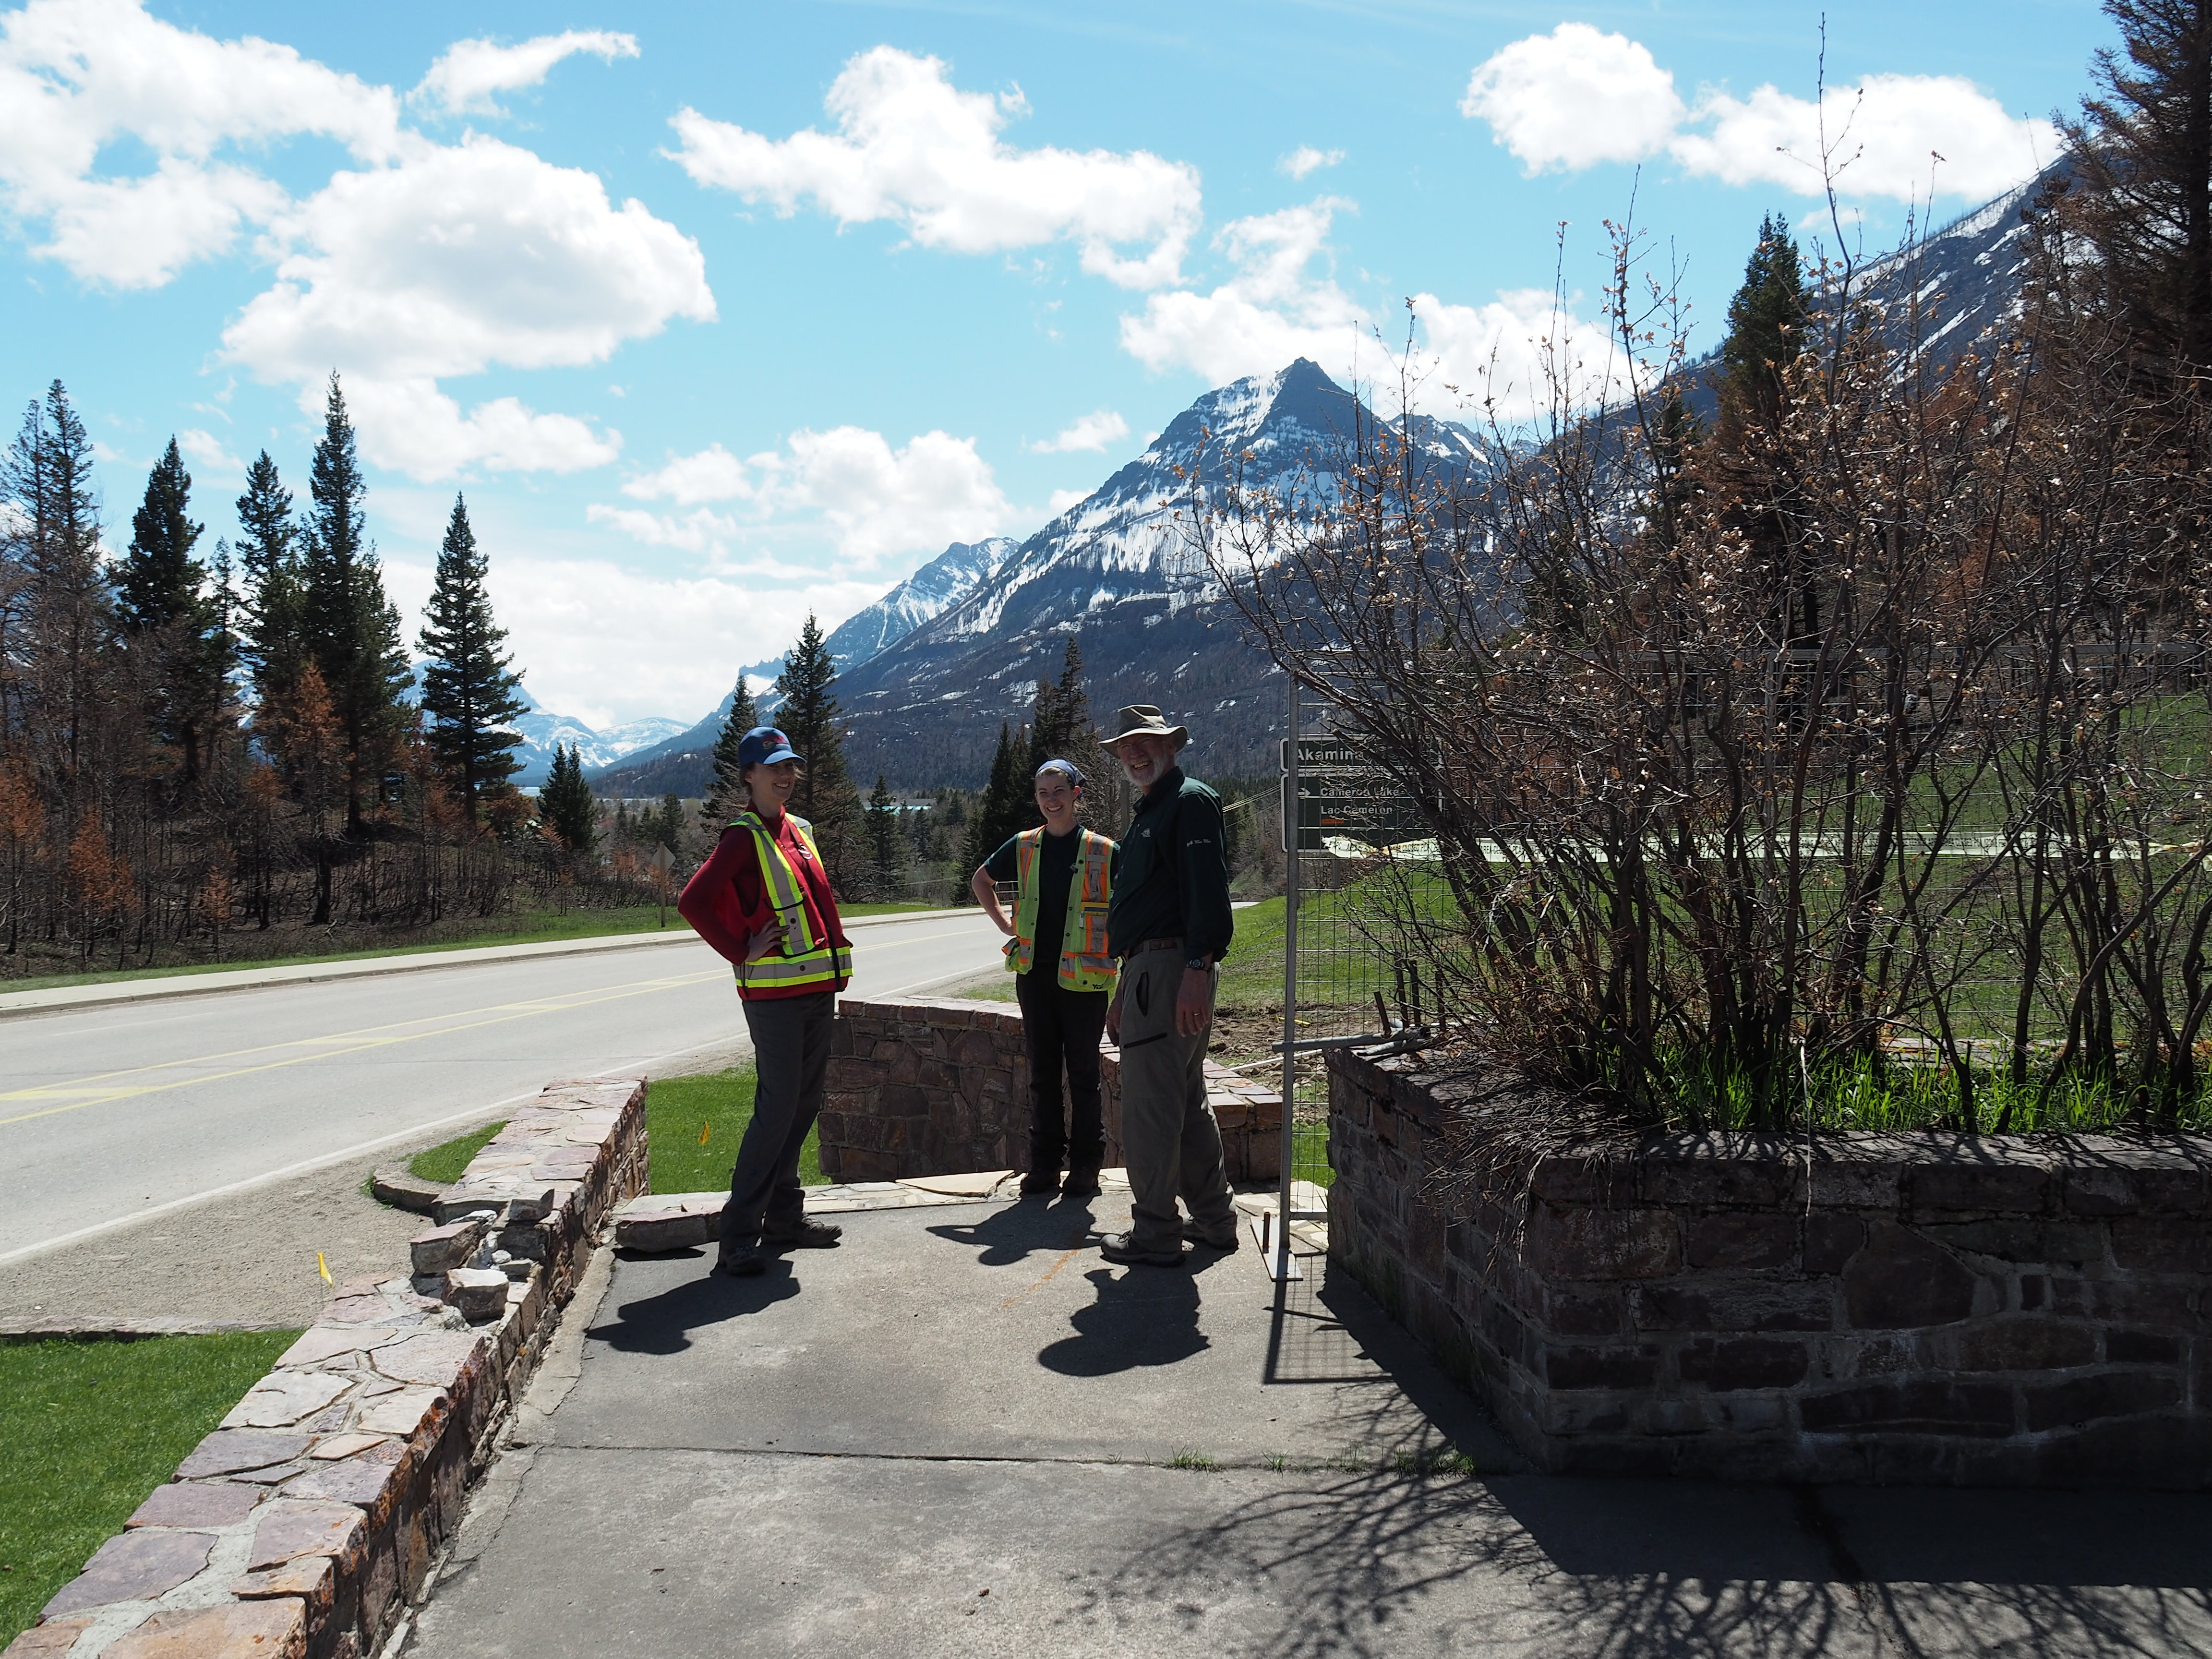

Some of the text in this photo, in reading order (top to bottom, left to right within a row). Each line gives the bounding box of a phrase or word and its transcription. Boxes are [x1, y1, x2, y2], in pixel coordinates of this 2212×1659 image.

[1321, 787, 1370, 796] Cameron
[1321, 805, 1393, 815] Lac Cameron
